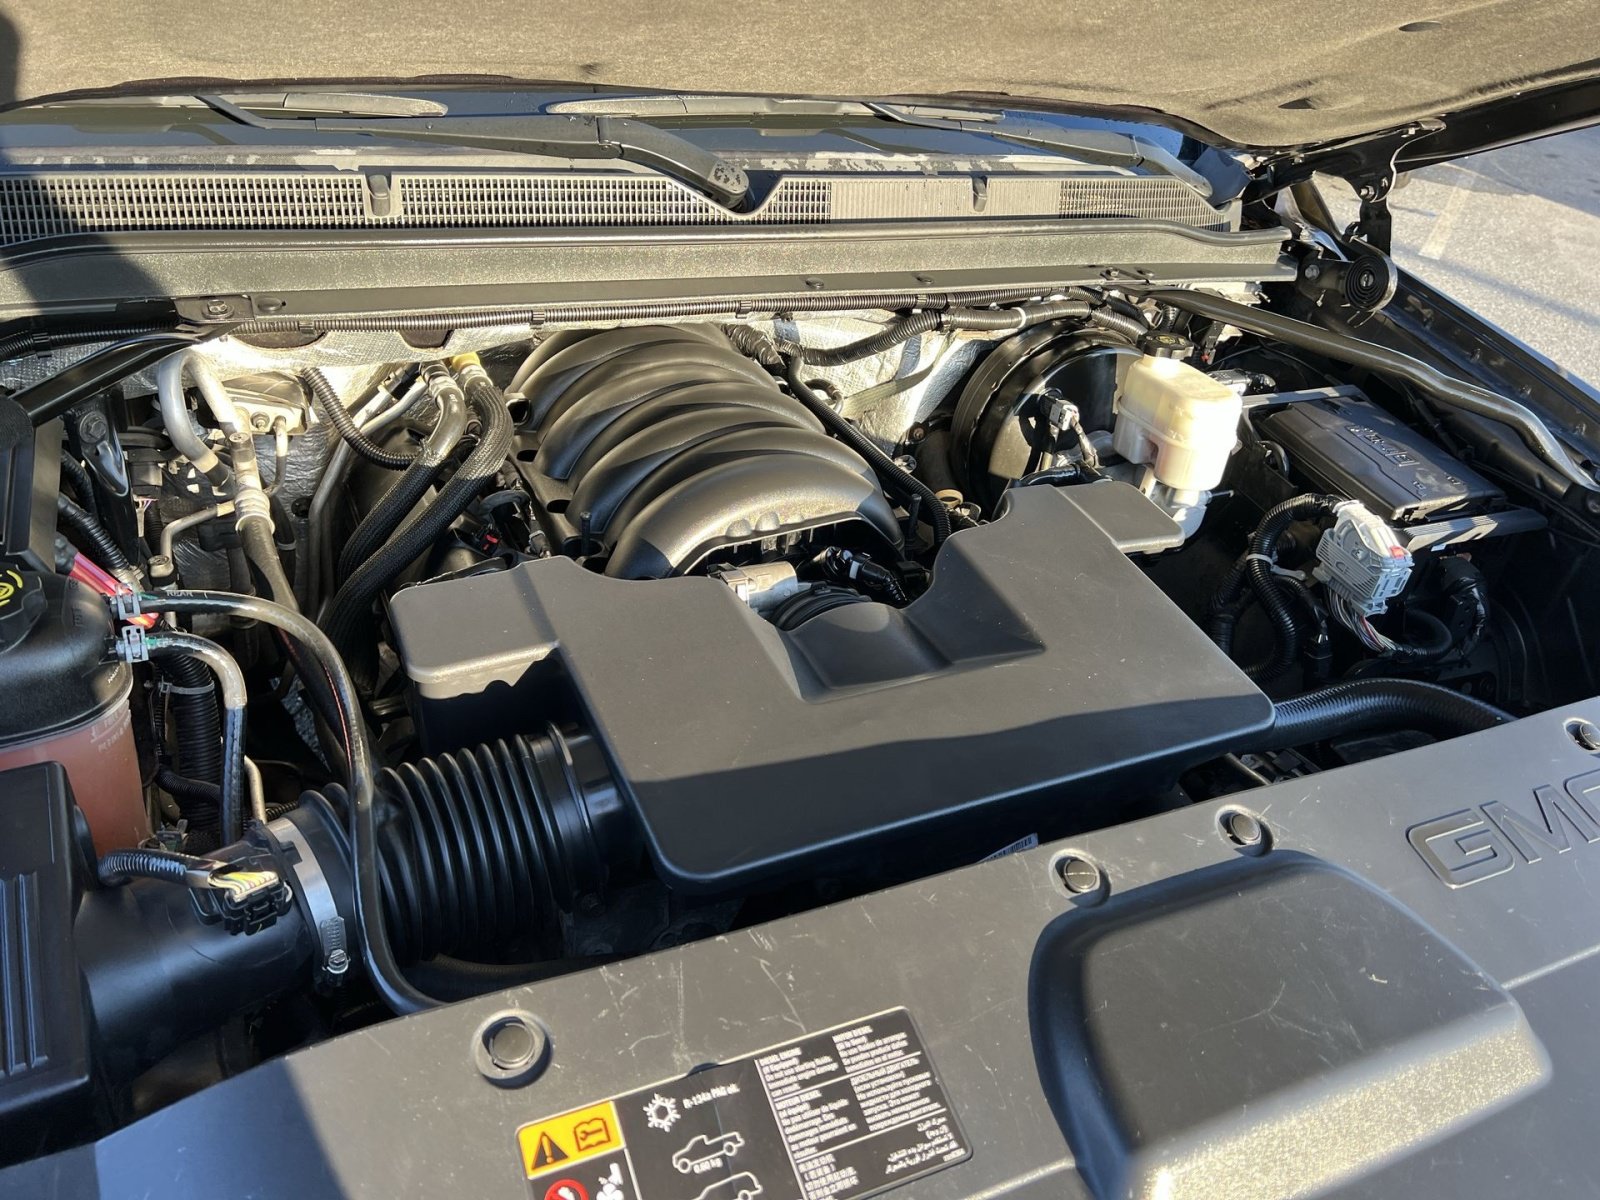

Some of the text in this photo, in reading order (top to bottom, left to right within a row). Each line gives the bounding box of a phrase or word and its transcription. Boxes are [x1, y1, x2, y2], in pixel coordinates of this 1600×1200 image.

[166, 589, 194, 599] REAR
[832, 1026, 872, 1043] MOTOR DIESEL
[759, 1048, 801, 1066] DIESEL ENGINE
[765, 1074, 774, 1082] Do
[774, 1071, 784, 1079] not
[783, 1068, 795, 1076] use
[794, 1061, 816, 1072] starting
[797, 1070, 816, 1080] engine
[816, 1063, 838, 1074] damage
[683, 1091, 712, 1109] R-134a
[710, 1086, 727, 1098] PAG
[775, 1090, 821, 1110] MOTEUR DIESEL
[710, 1158, 723, 1168] kg
